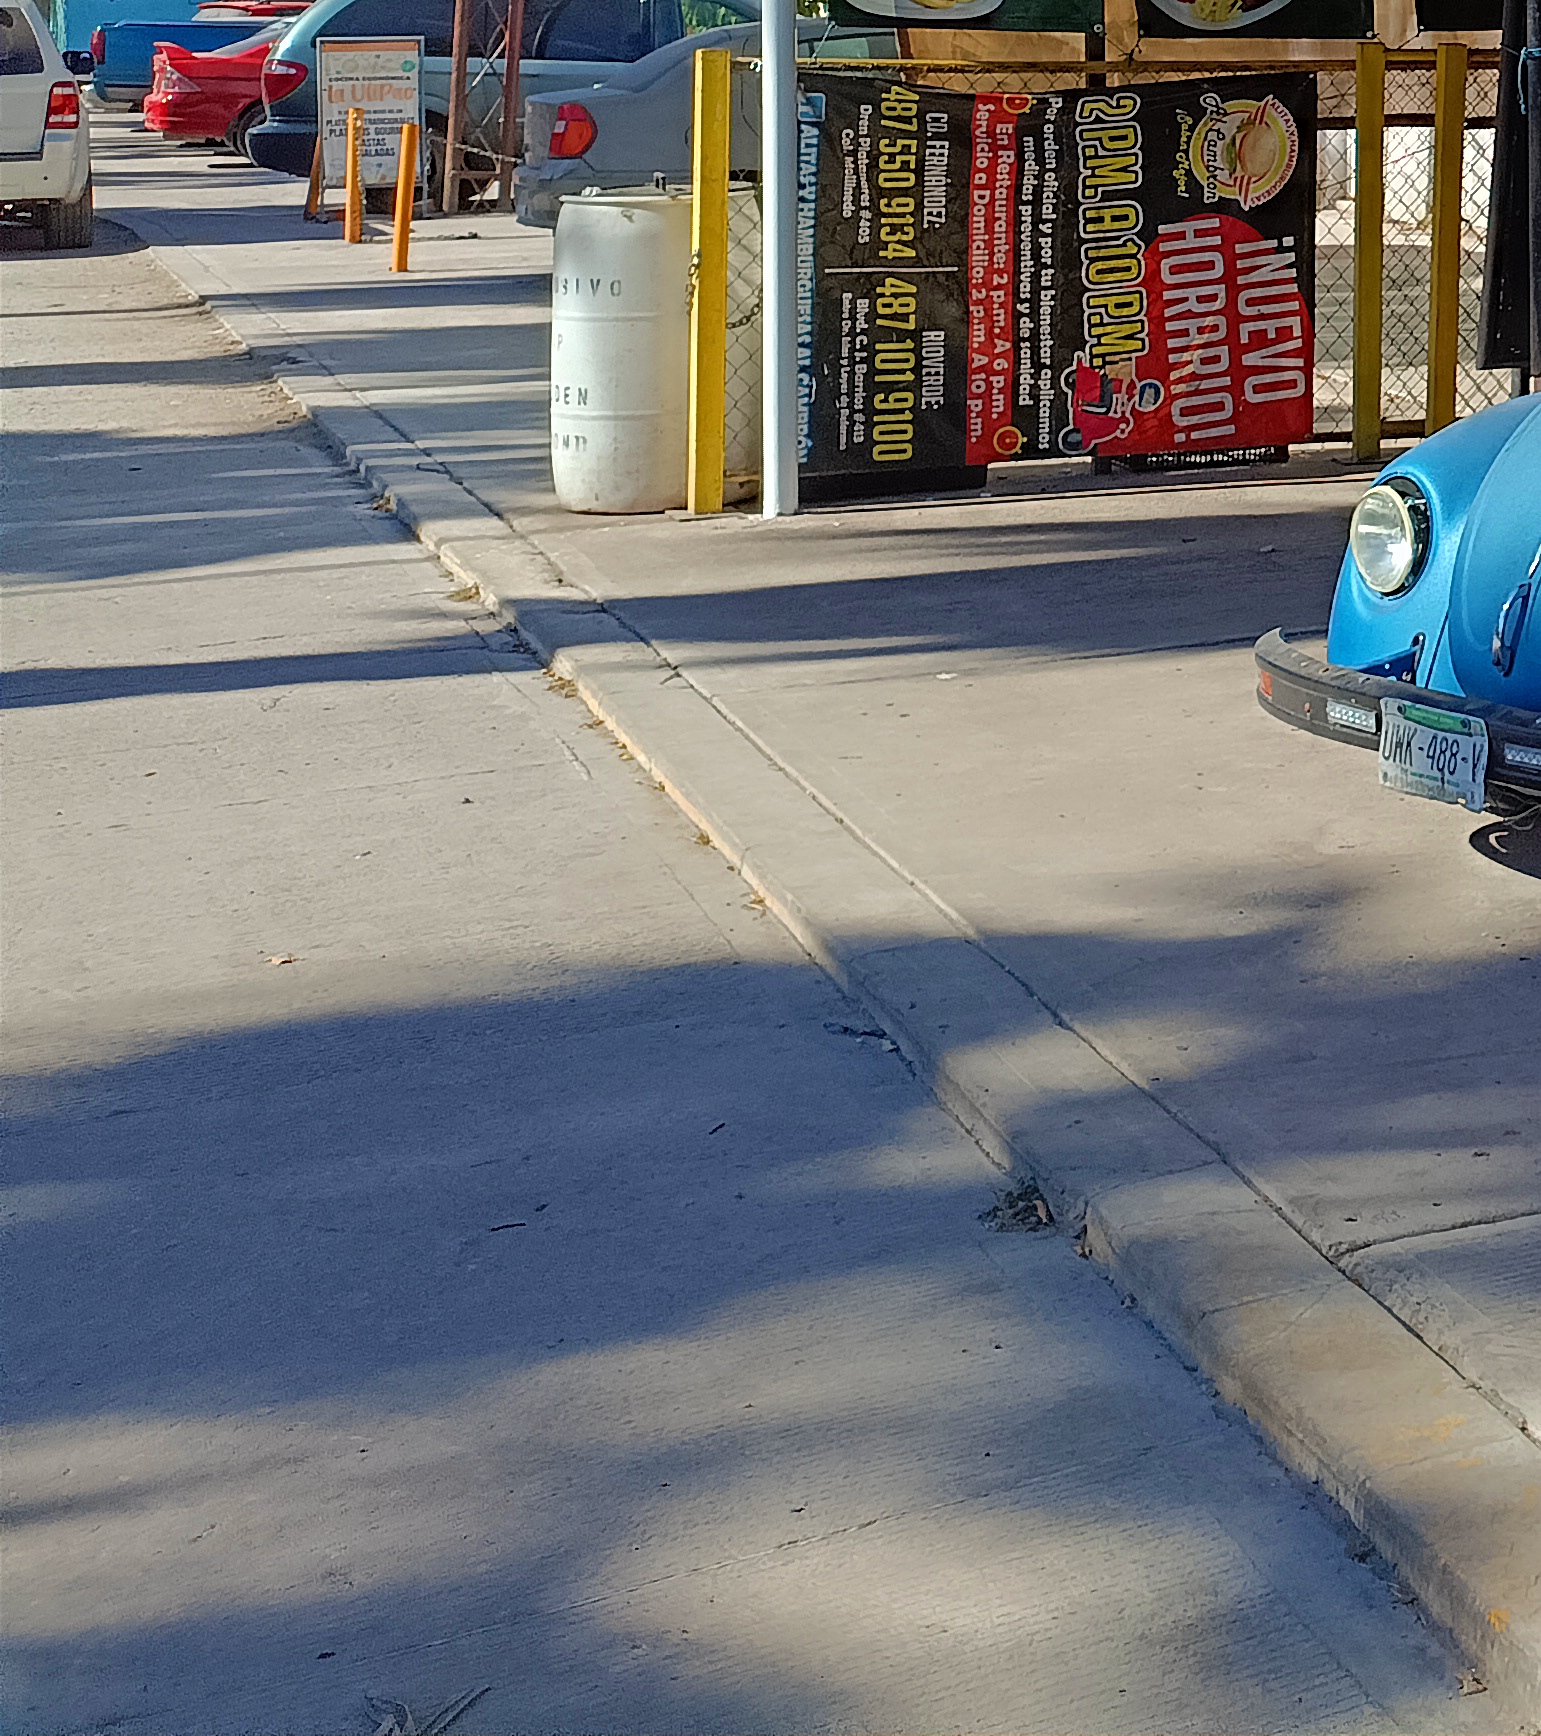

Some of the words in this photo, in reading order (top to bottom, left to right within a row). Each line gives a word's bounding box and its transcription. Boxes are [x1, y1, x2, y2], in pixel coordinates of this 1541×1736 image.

[858, 104, 872, 135] Dren
[880, 86, 919, 131] 487
[925, 112, 948, 136] CD.
[1045, 97, 1062, 120] Por
[1081, 97, 1137, 119] 2
[975, 103, 995, 168] Servicio
[996, 123, 1013, 145] En
[1043, 124, 1059, 169] orden
[878, 138, 917, 188] 550
[973, 172, 987, 185] a
[1022, 136, 1039, 201] medidas
[1081, 126, 1138, 198] P.M.
[922, 140, 951, 229] FERNÁNDEZ:
[1042, 172, 1058, 219] oficial
[857, 209, 872, 244] #405
[879, 197, 916, 259] 9134
[993, 150, 1014, 269] Restaurante:
[1039, 222, 1053, 233] y
[1084, 205, 1139, 233] A
[971, 189, 990, 284] Domicilio:
[1019, 205, 1035, 299] preventivas
[1038, 237, 1052, 265] por
[993, 273, 1008, 285] 2
[1040, 268, 1054, 286] tu
[1086, 240, 1141, 284] 10
[876, 277, 917, 330] 487
[971, 288, 986, 300] 2
[990, 290, 1006, 334] p.m.
[1017, 303, 1032, 314] y
[969, 305, 985, 348] p.m.
[1019, 317, 1034, 338] de
[1040, 290, 1055, 364] bienestar
[1088, 292, 1144, 368] P.M.
[1158, 218, 1235, 443] HORARIO!
[1235, 236, 1305, 403] ¡NUEVO
[875, 338, 915, 382] 101
[971, 353, 988, 368] A
[993, 338, 1011, 353] A
[993, 358, 1008, 370] 6
[921, 330, 945, 409] RIOVERDE:
[971, 372, 986, 394] 10
[1019, 342, 1035, 406] sanidad
[990, 375, 1006, 419] p.m.
[1038, 368, 1054, 449] aplicamos
[873, 392, 914, 461] 9100
[967, 399, 983, 443] p.m.
